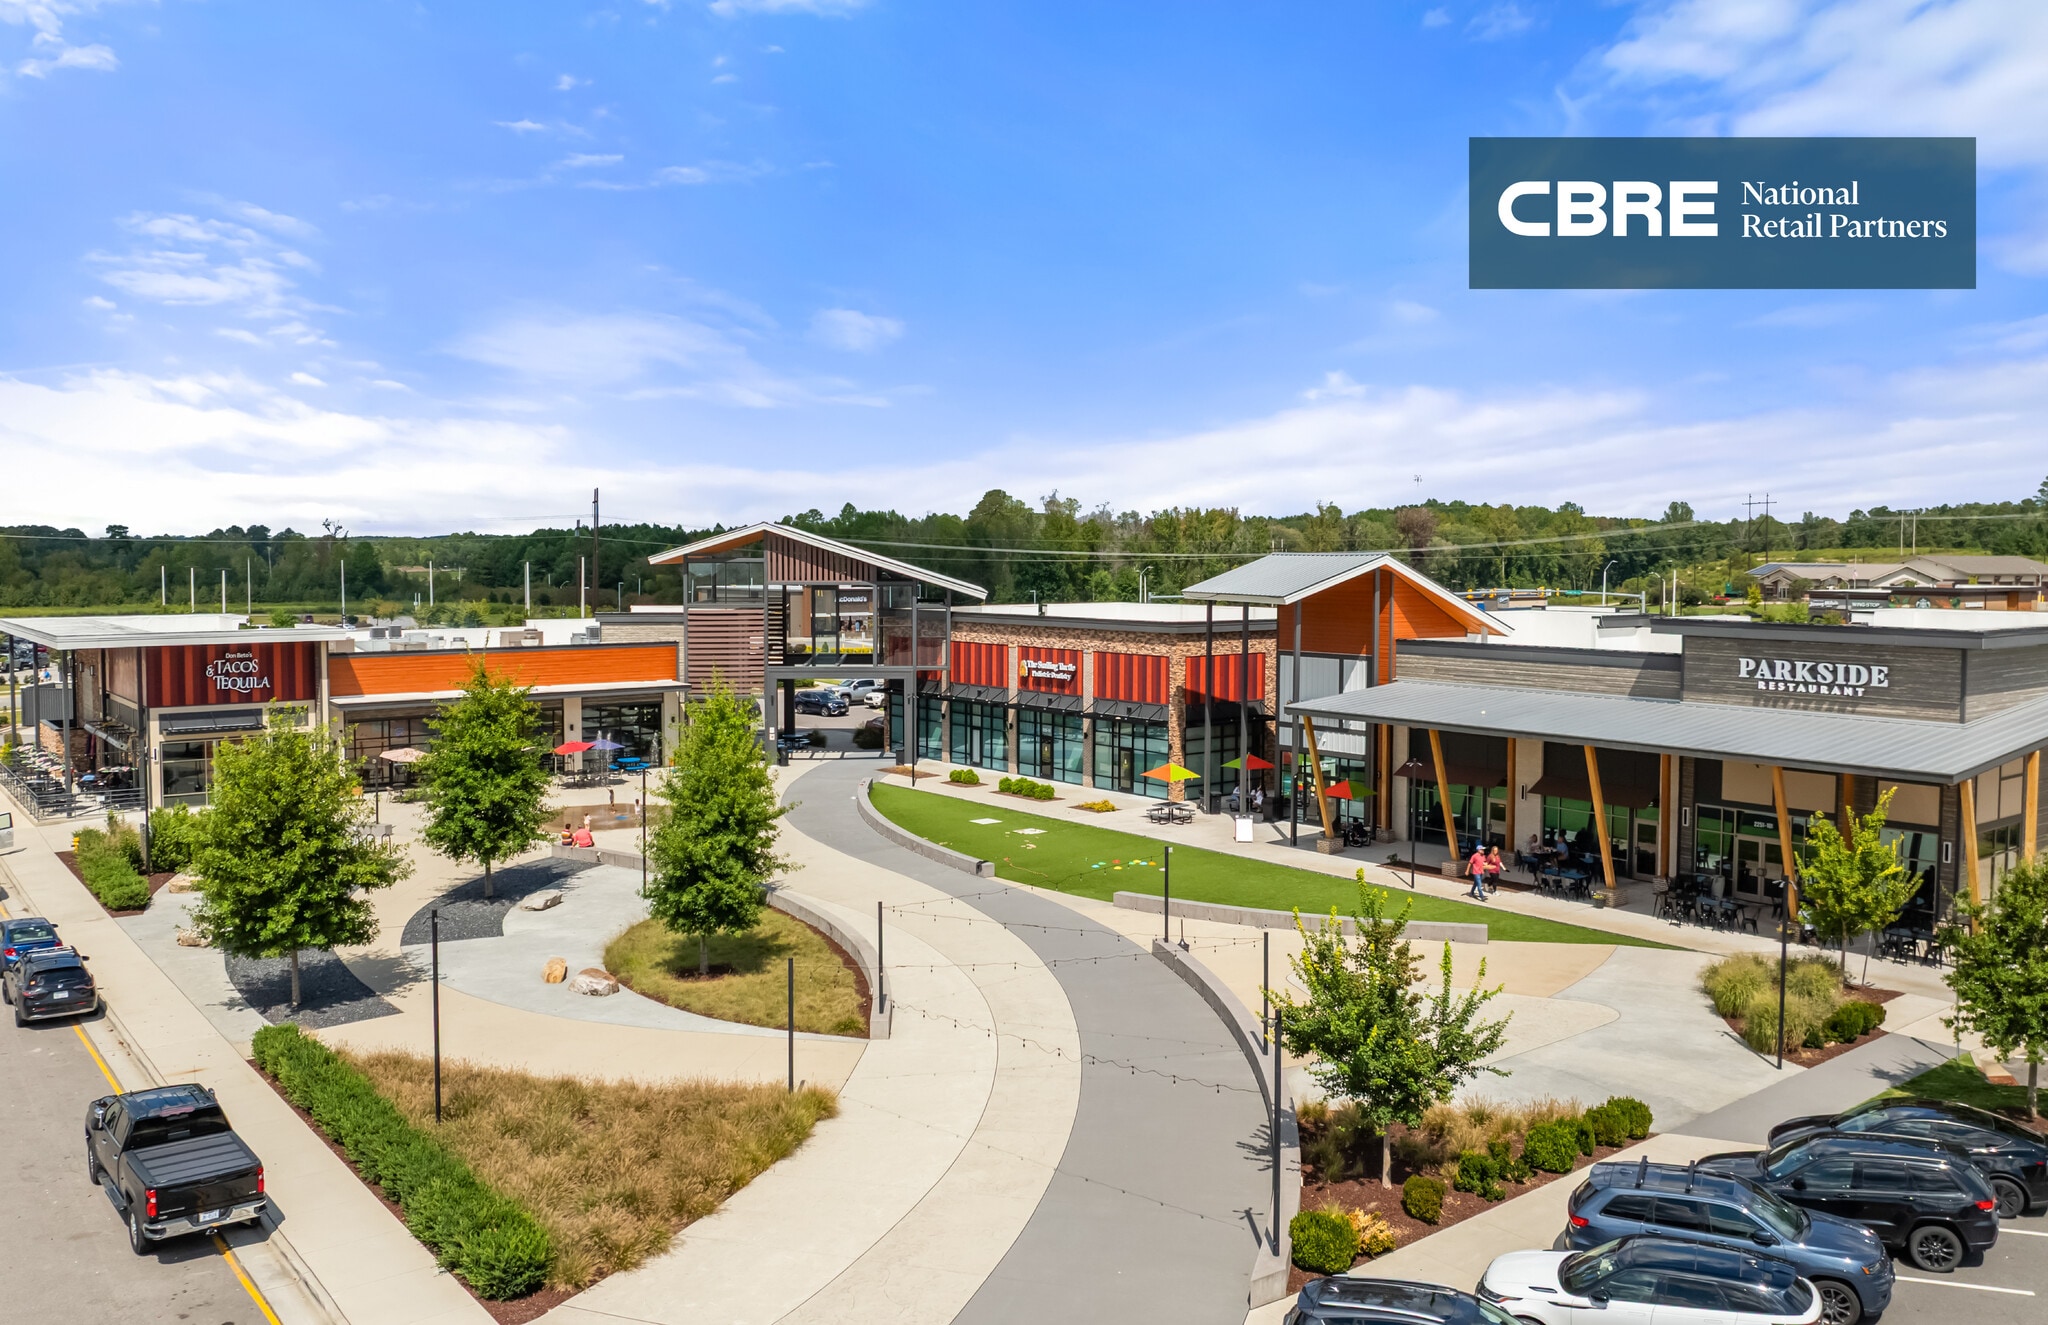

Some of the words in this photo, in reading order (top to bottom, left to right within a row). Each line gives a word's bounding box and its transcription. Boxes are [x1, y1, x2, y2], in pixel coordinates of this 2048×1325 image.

[213, 659, 259, 674] TACOS
[1027, 660, 1037, 669] The
[1738, 658, 1889, 687] PARKSIDE
[212, 675, 271, 693] TEQUILA
[1758, 681, 1866, 697] RESTAURANT
